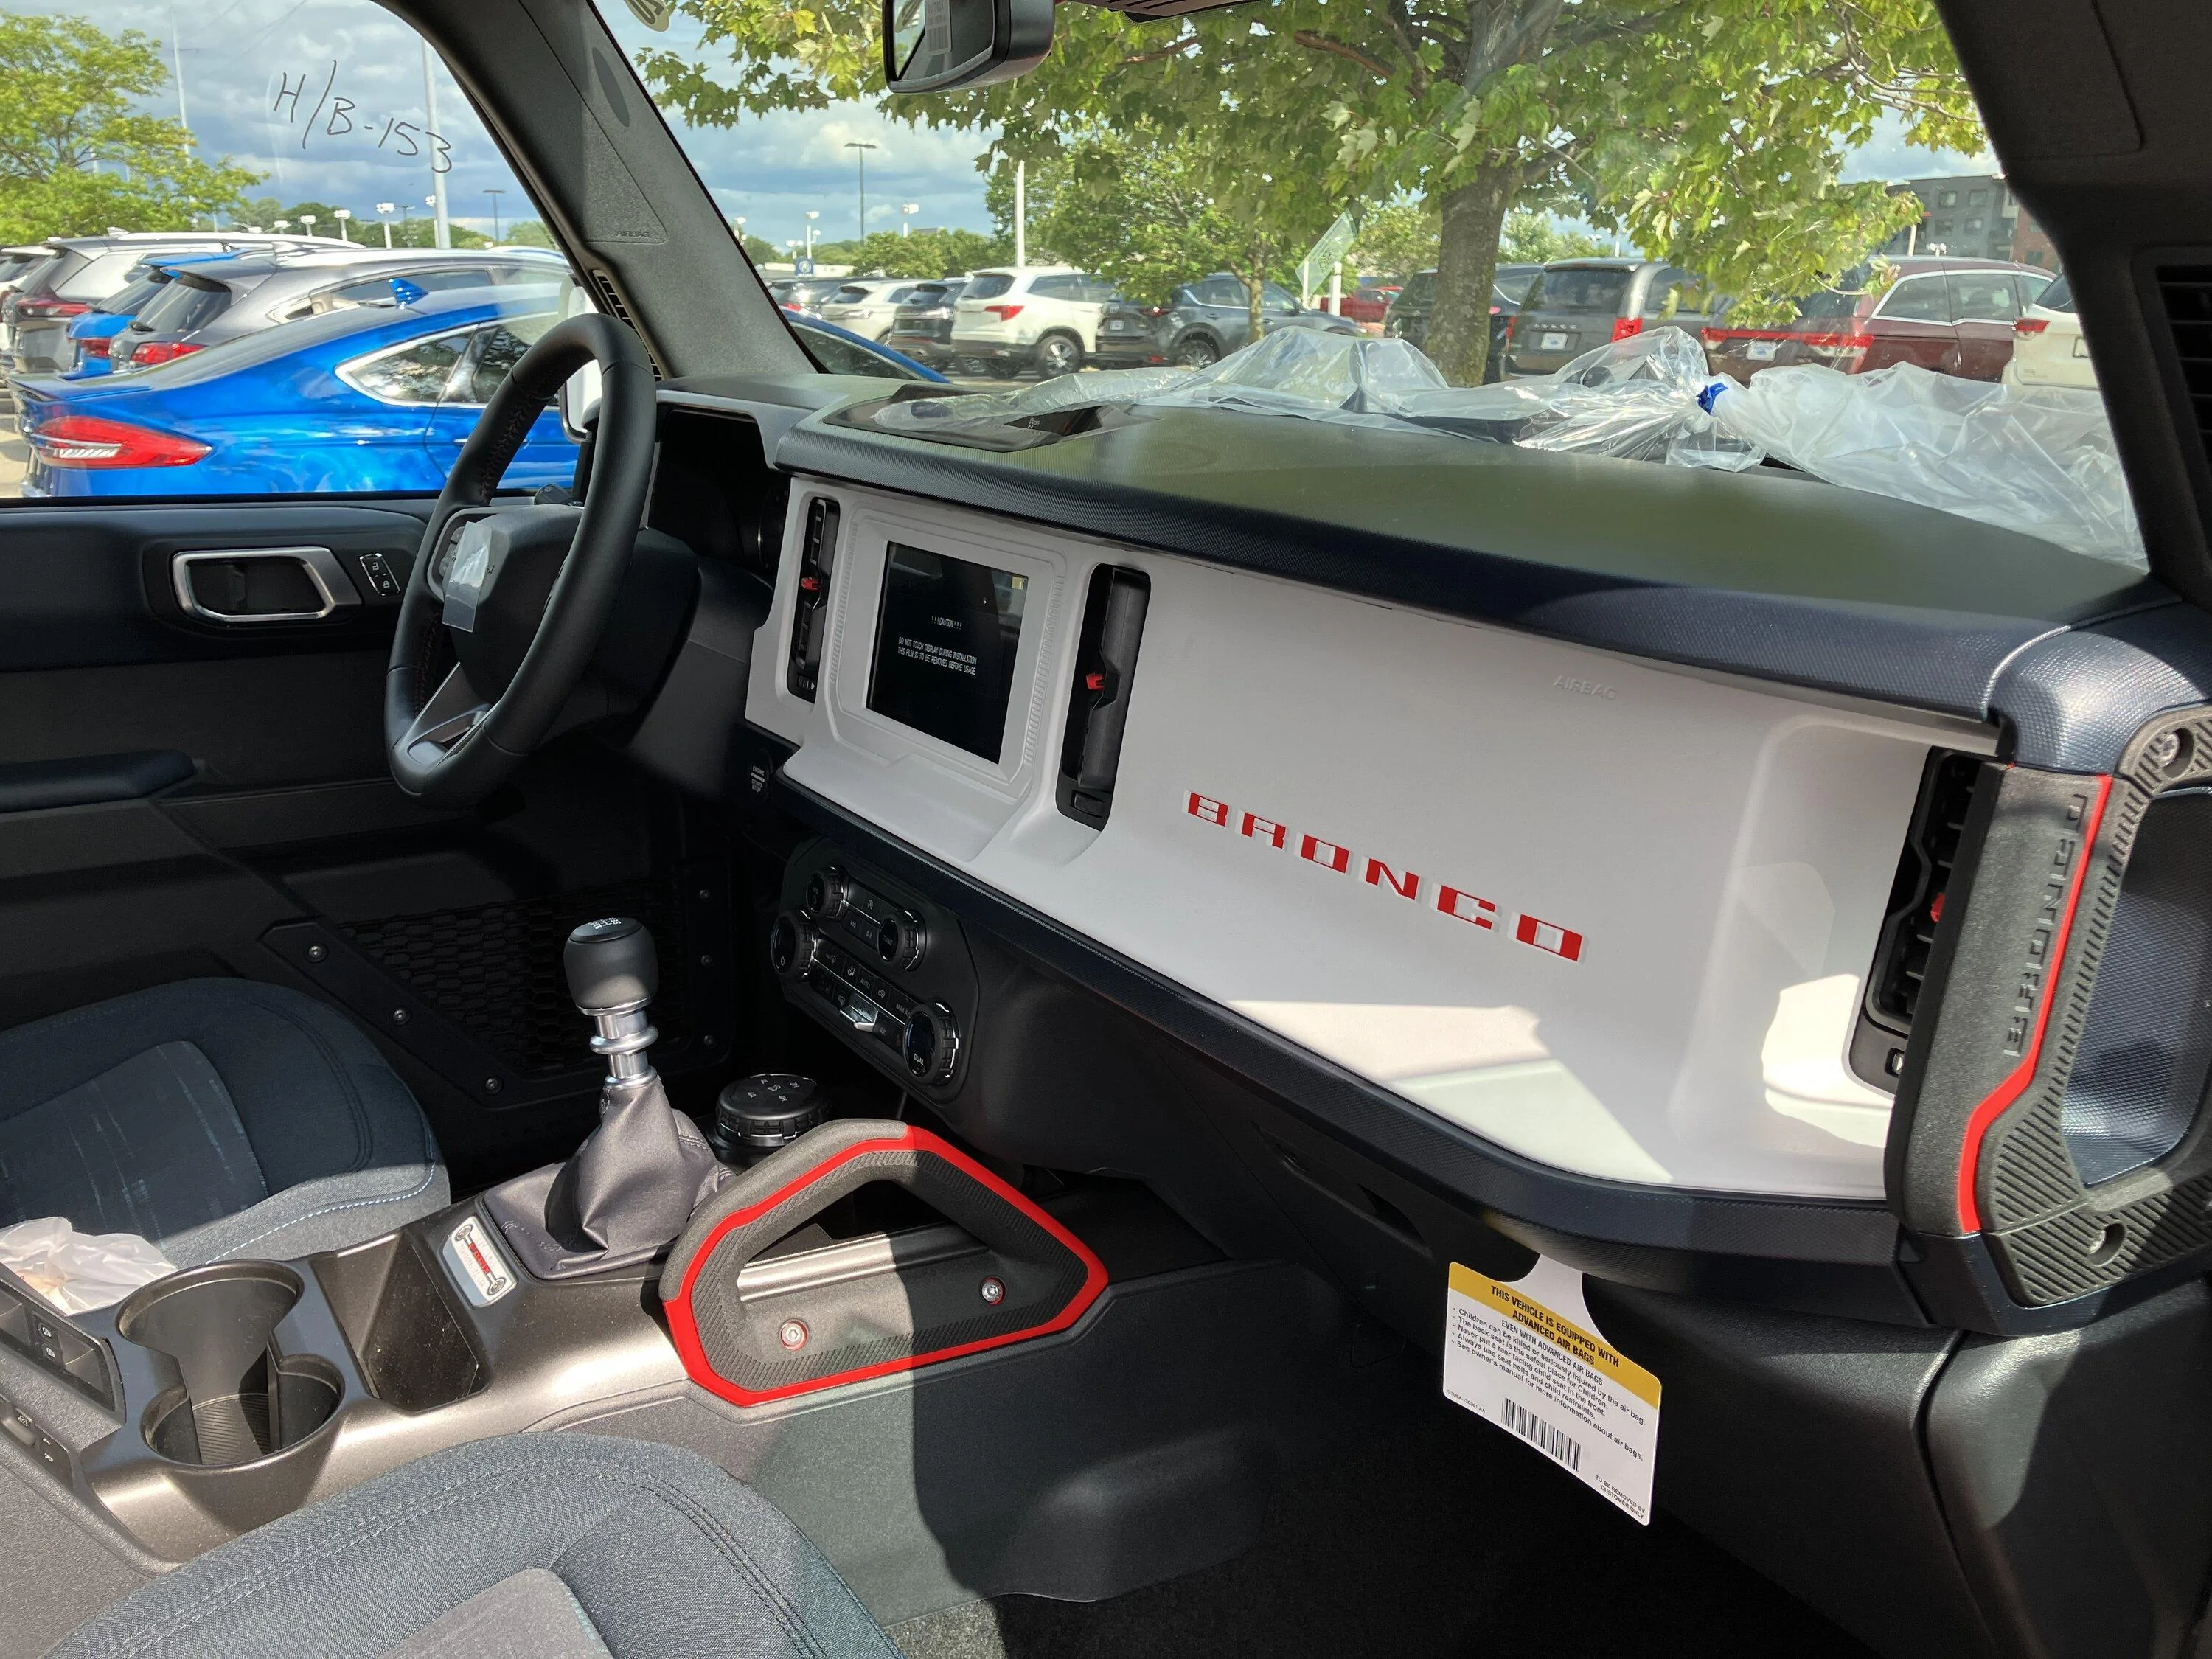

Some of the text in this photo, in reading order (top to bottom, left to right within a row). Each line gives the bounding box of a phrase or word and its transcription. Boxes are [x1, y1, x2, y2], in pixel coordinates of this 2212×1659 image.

[913, 640, 924, 650] TOUCH
[925, 644, 939, 654] DISPLAY
[939, 647, 952, 658] DURING
[953, 651, 977, 665] INSTALLATION
[931, 655, 947, 667] REMOVED
[948, 661, 963, 672] BEFORE
[963, 665, 976, 675] USAGE
[1553, 675, 1617, 700] AIRBAG
[1182, 790, 1587, 963] BRONCO
[2003, 793, 2089, 1057] BRONCO
[1458, 1315, 1608, 1409] The back seat is the safest place for Children.
[1458, 1308, 1487, 1326] Children
[1489, 1324, 1501, 1335] can
[1503, 1331, 1512, 1340] be
[1513, 1336, 1530, 1351] killed
[1540, 1354, 1571, 1377] seriously
[1573, 1373, 1596, 1392] injured
[1597, 1388, 1606, 1399] by
[1607, 1395, 1618, 1407] the
[1620, 1404, 1630, 1413] air
[1630, 1410, 1645, 1425] bag.
[1491, 1285, 1619, 1368] THIS VEHICLE IS EQUIPPED WITH
[1501, 1319, 1603, 1385] EVEN WITH ADVANCED AIR BAGS
[1512, 1310, 1594, 1365] ADVANCED AIR BAGS
[1457, 1333, 1595, 1419] Always use seat belts and child restraints.
[1457, 1340, 1643, 1461] See owner's manual for more information about air bags.
[1458, 1324, 1478, 1339] Never
[1479, 1336, 1491, 1346] put
[1498, 1346, 1511, 1357] rear
[1512, 1353, 1533, 1371] facing
[1534, 1367, 1551, 1380] child
[1552, 1378, 1567, 1391] seat
[1568, 1387, 1574, 1396] in
[1575, 1392, 1586, 1404] the
[1587, 1399, 1606, 1416] front.
[1595, 1474, 1646, 1514] TO BE REMOVED BY
[1600, 1485, 1644, 1520] CUSTOMER ONLY
